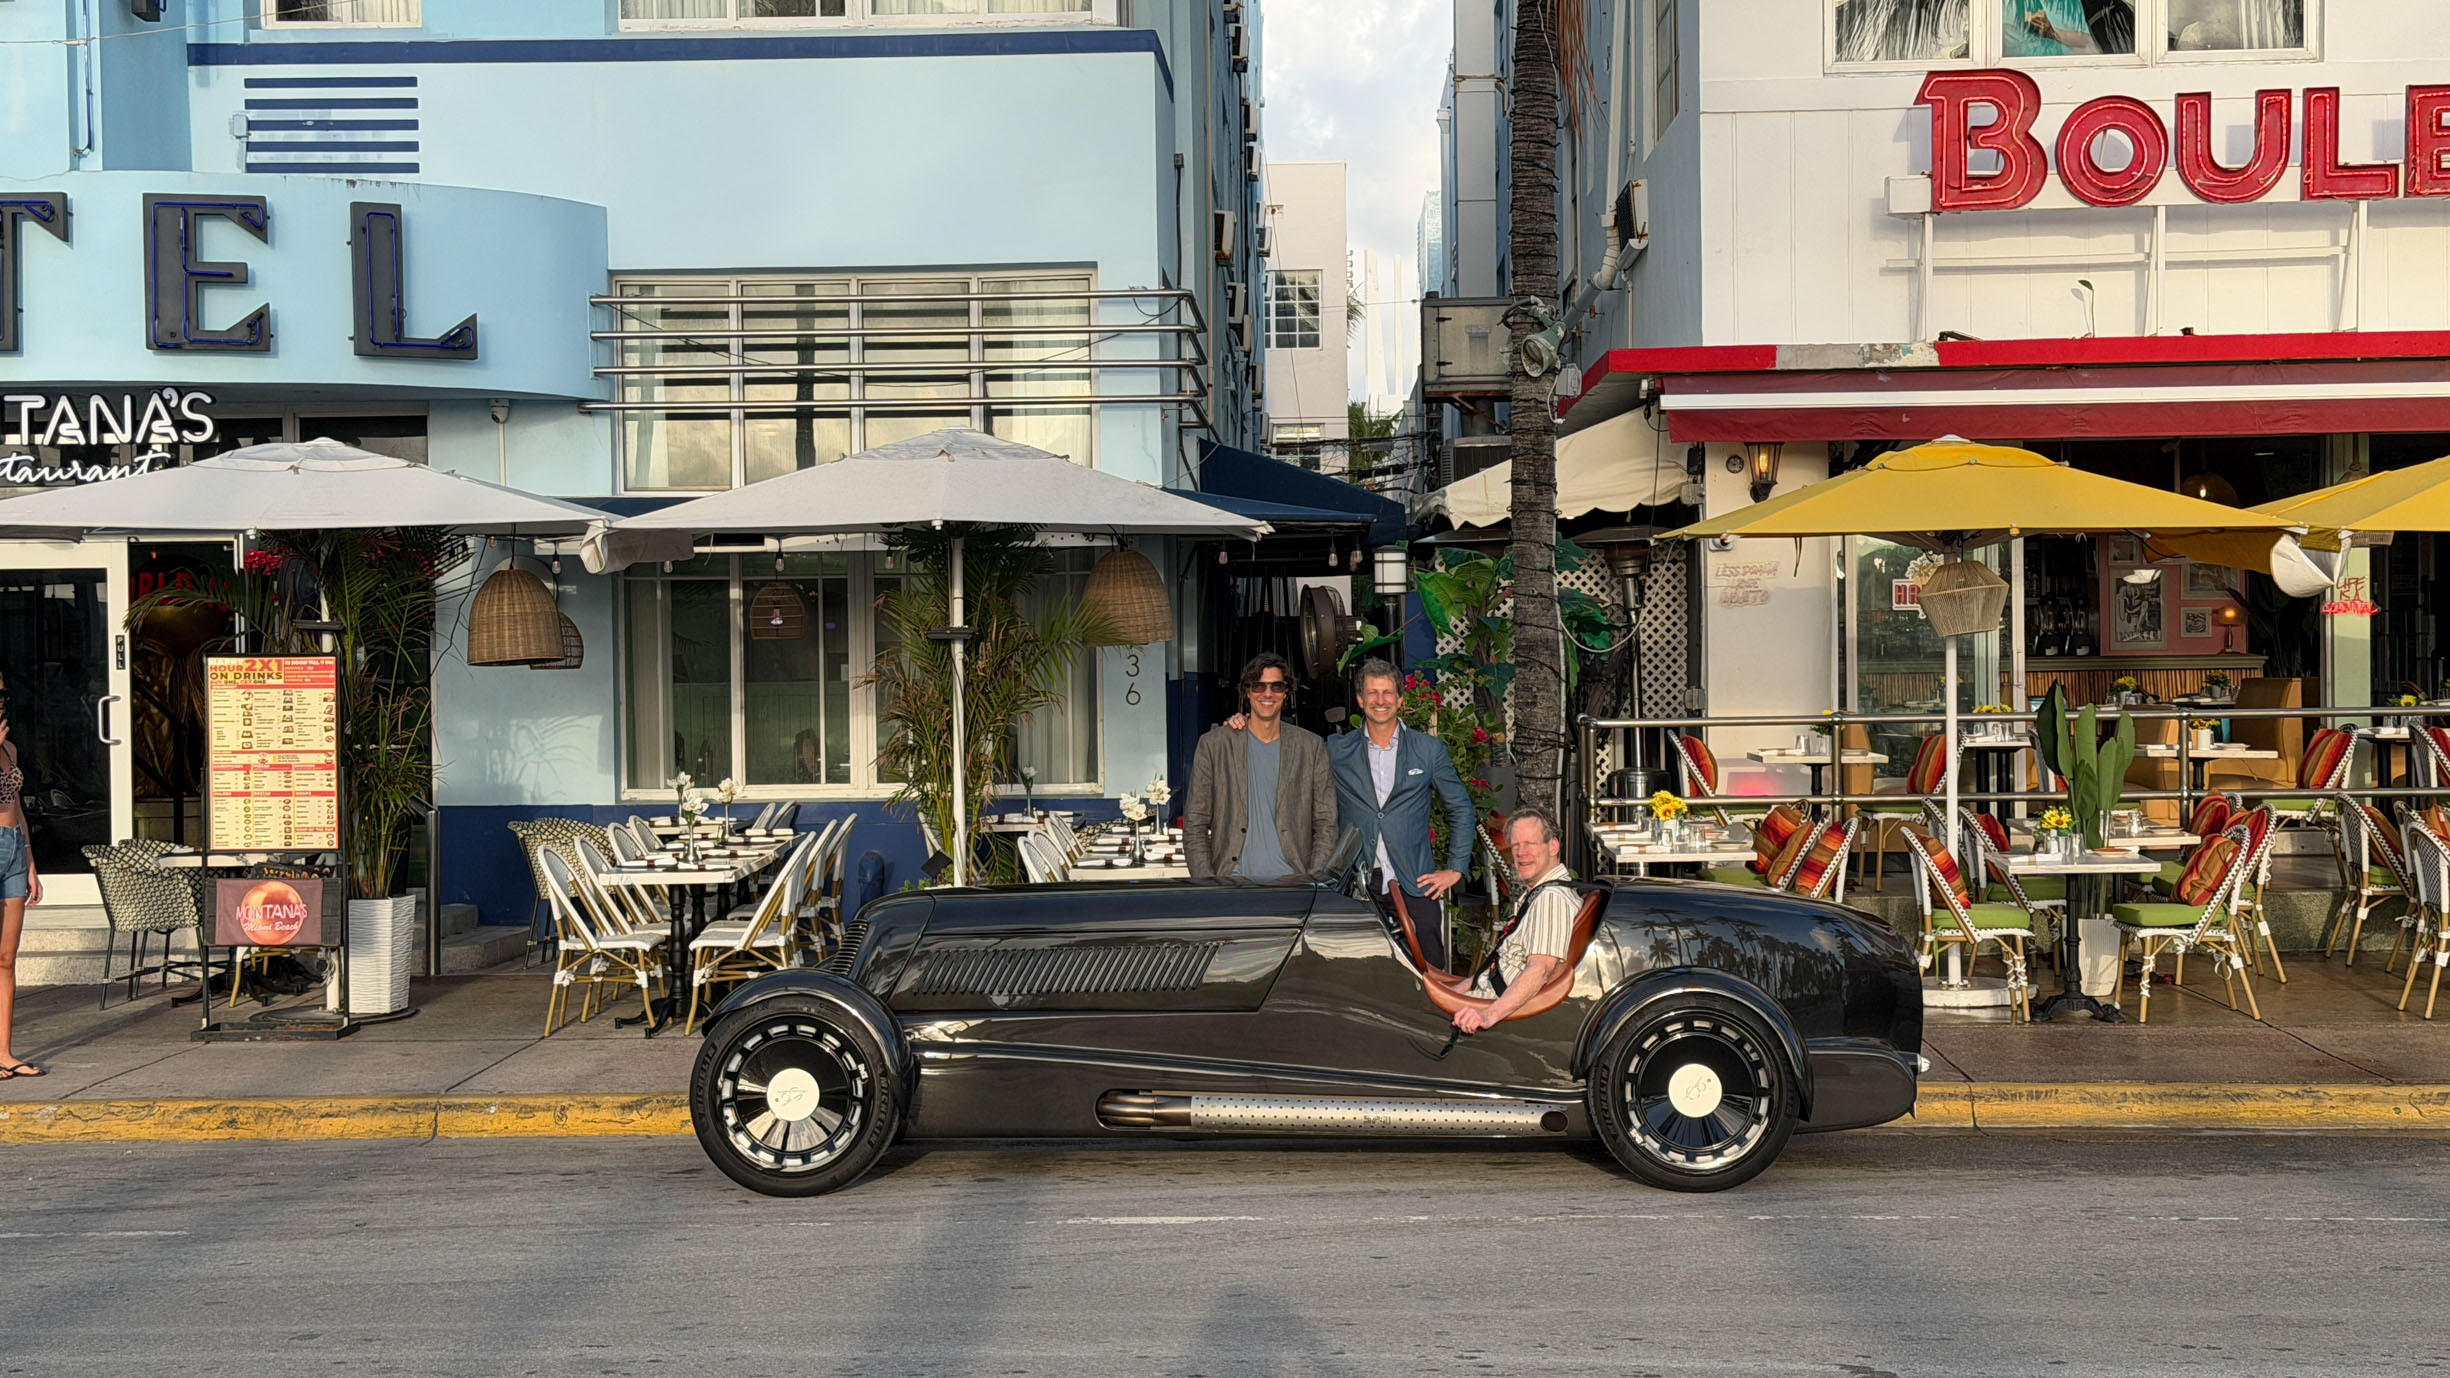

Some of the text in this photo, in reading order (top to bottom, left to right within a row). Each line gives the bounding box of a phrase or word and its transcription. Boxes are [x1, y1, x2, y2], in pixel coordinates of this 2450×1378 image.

[3, 387, 214, 445] TANA'S
[2335, 576, 2367, 590] LIFE
[210, 664, 244, 672] HOUR
[243, 658, 282, 672] 2X1
[210, 672, 228, 680] ON
[233, 671, 283, 680] DRINKS
[235, 903, 308, 921] MONTANA'S
[243, 920, 298, 932] Miami Beach
[870, 1076, 889, 1144] MICHELIN
